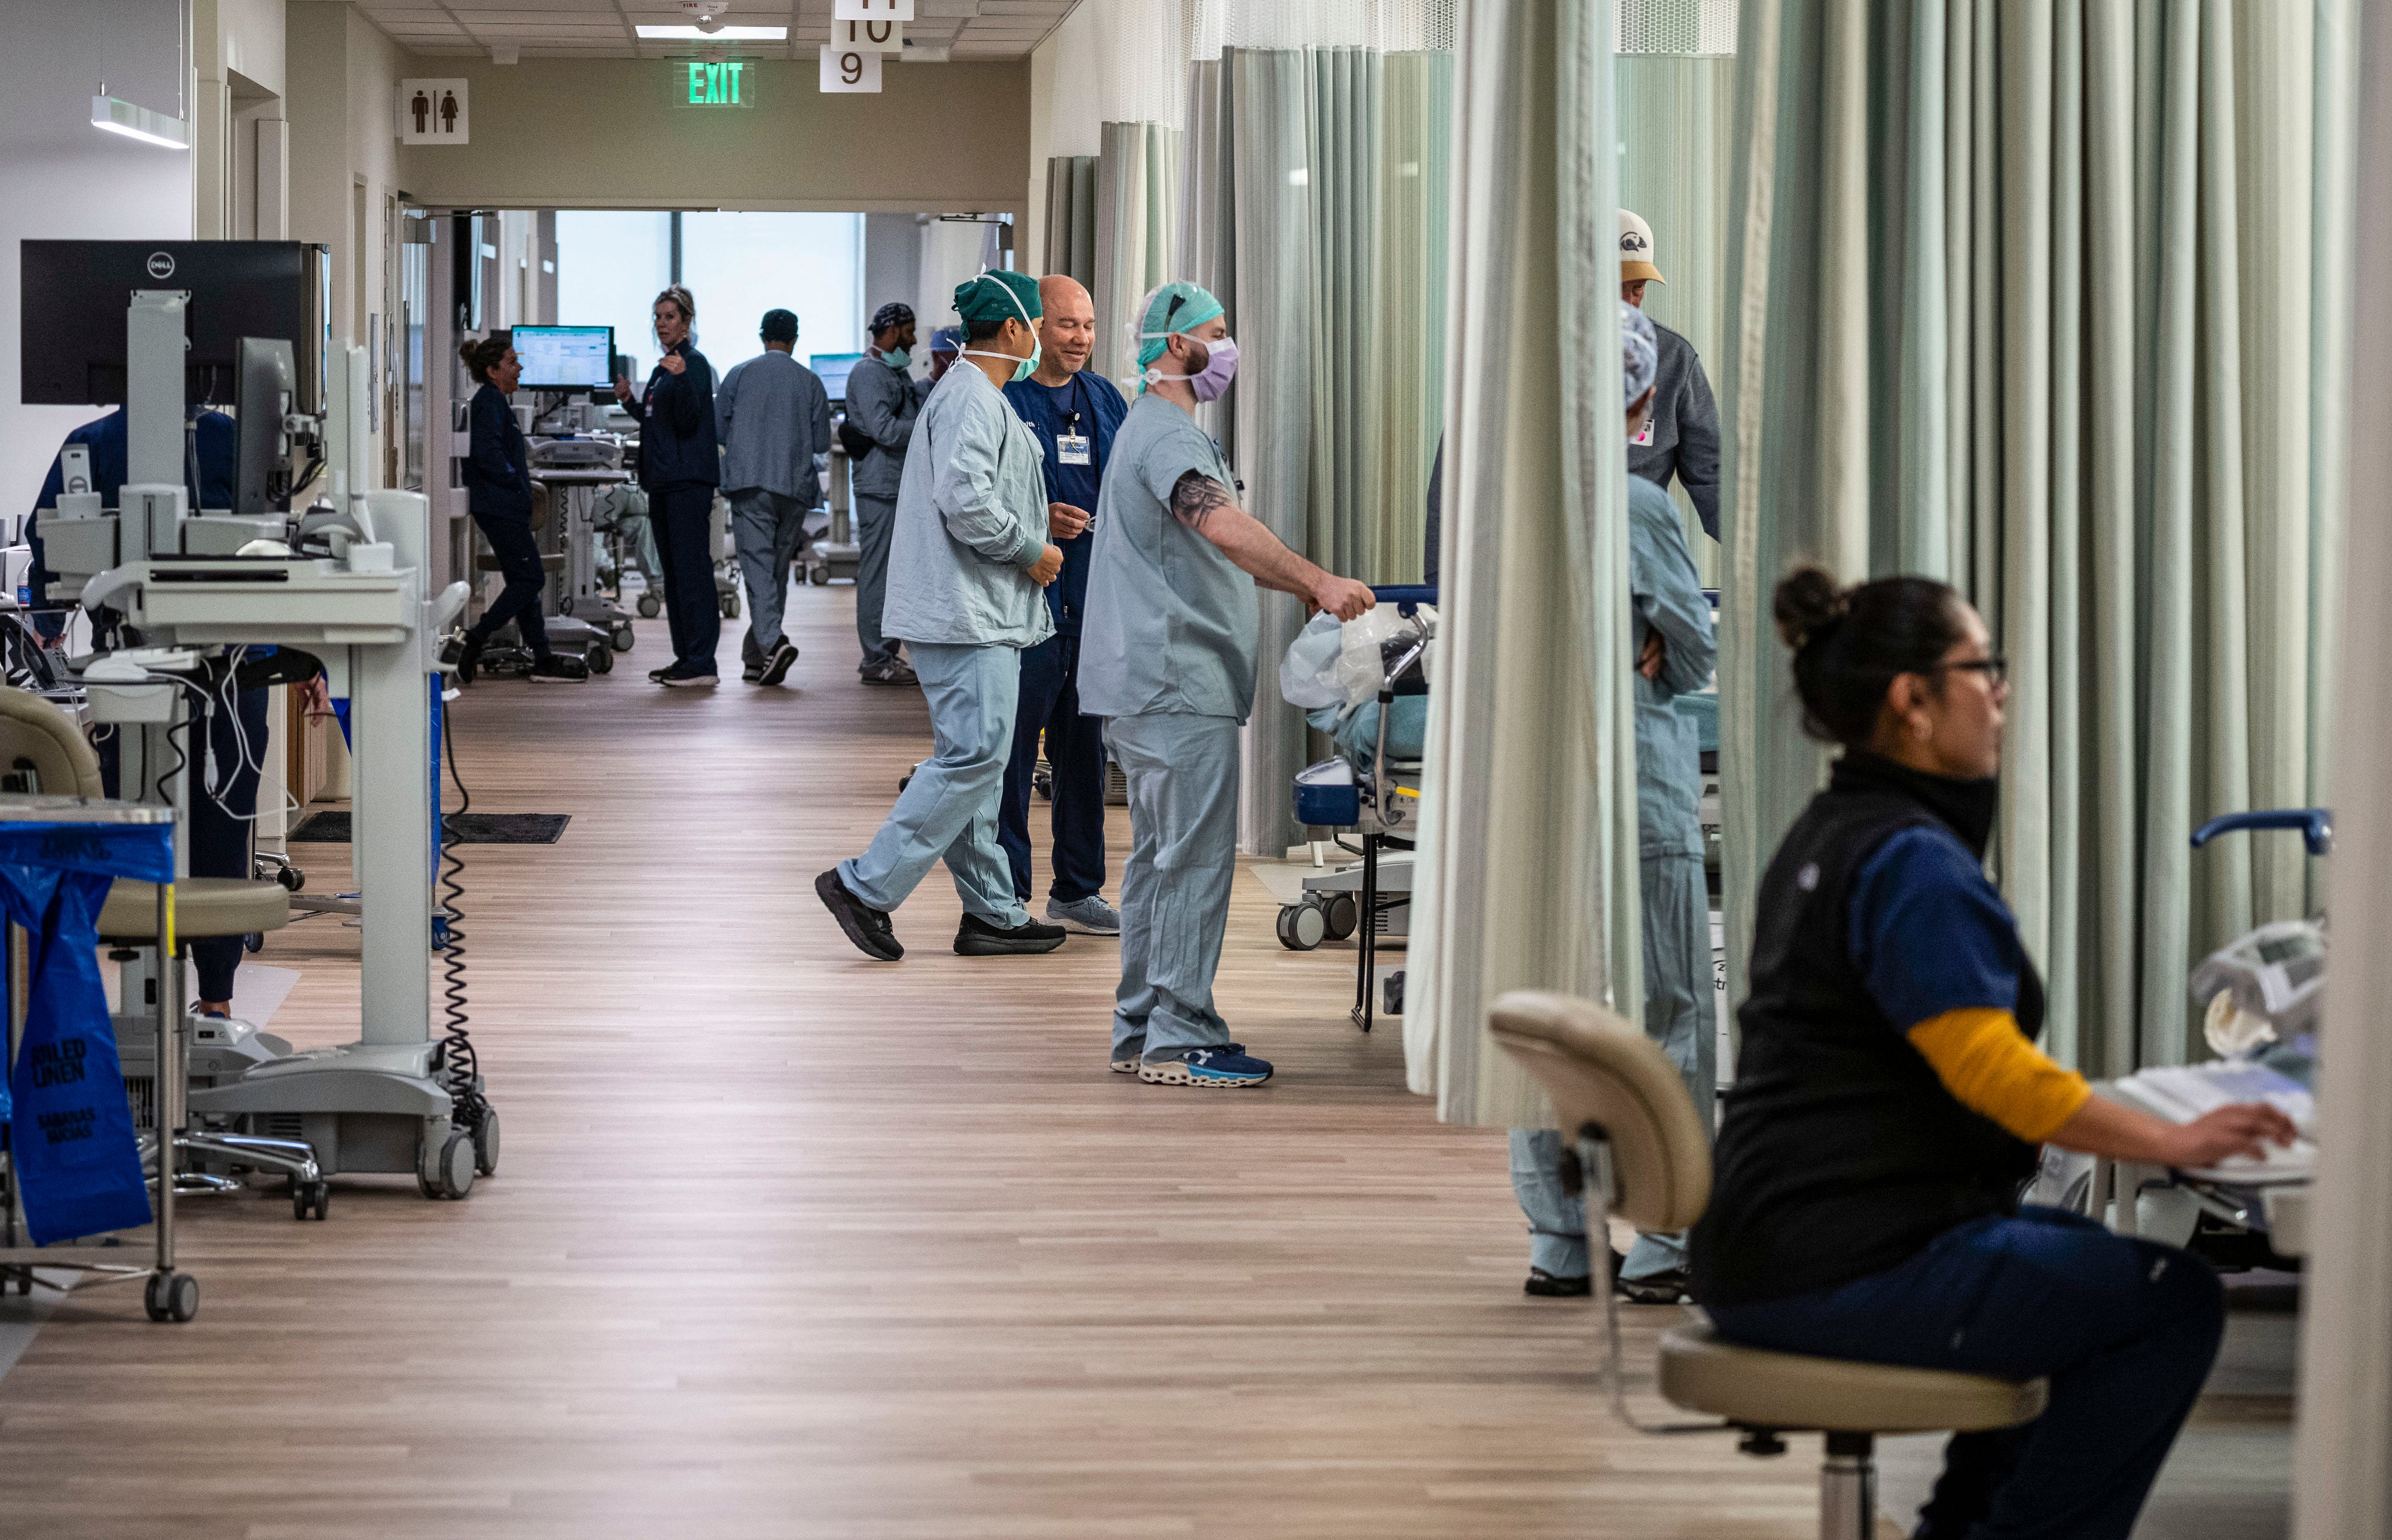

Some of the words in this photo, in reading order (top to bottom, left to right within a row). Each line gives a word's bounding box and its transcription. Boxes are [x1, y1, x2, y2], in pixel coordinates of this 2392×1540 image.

[689, 62, 743, 103] EXIT
[840, 52, 862, 84] 9
[151, 261, 171, 269] DELL
[31, 1060, 85, 1087] LINEN
